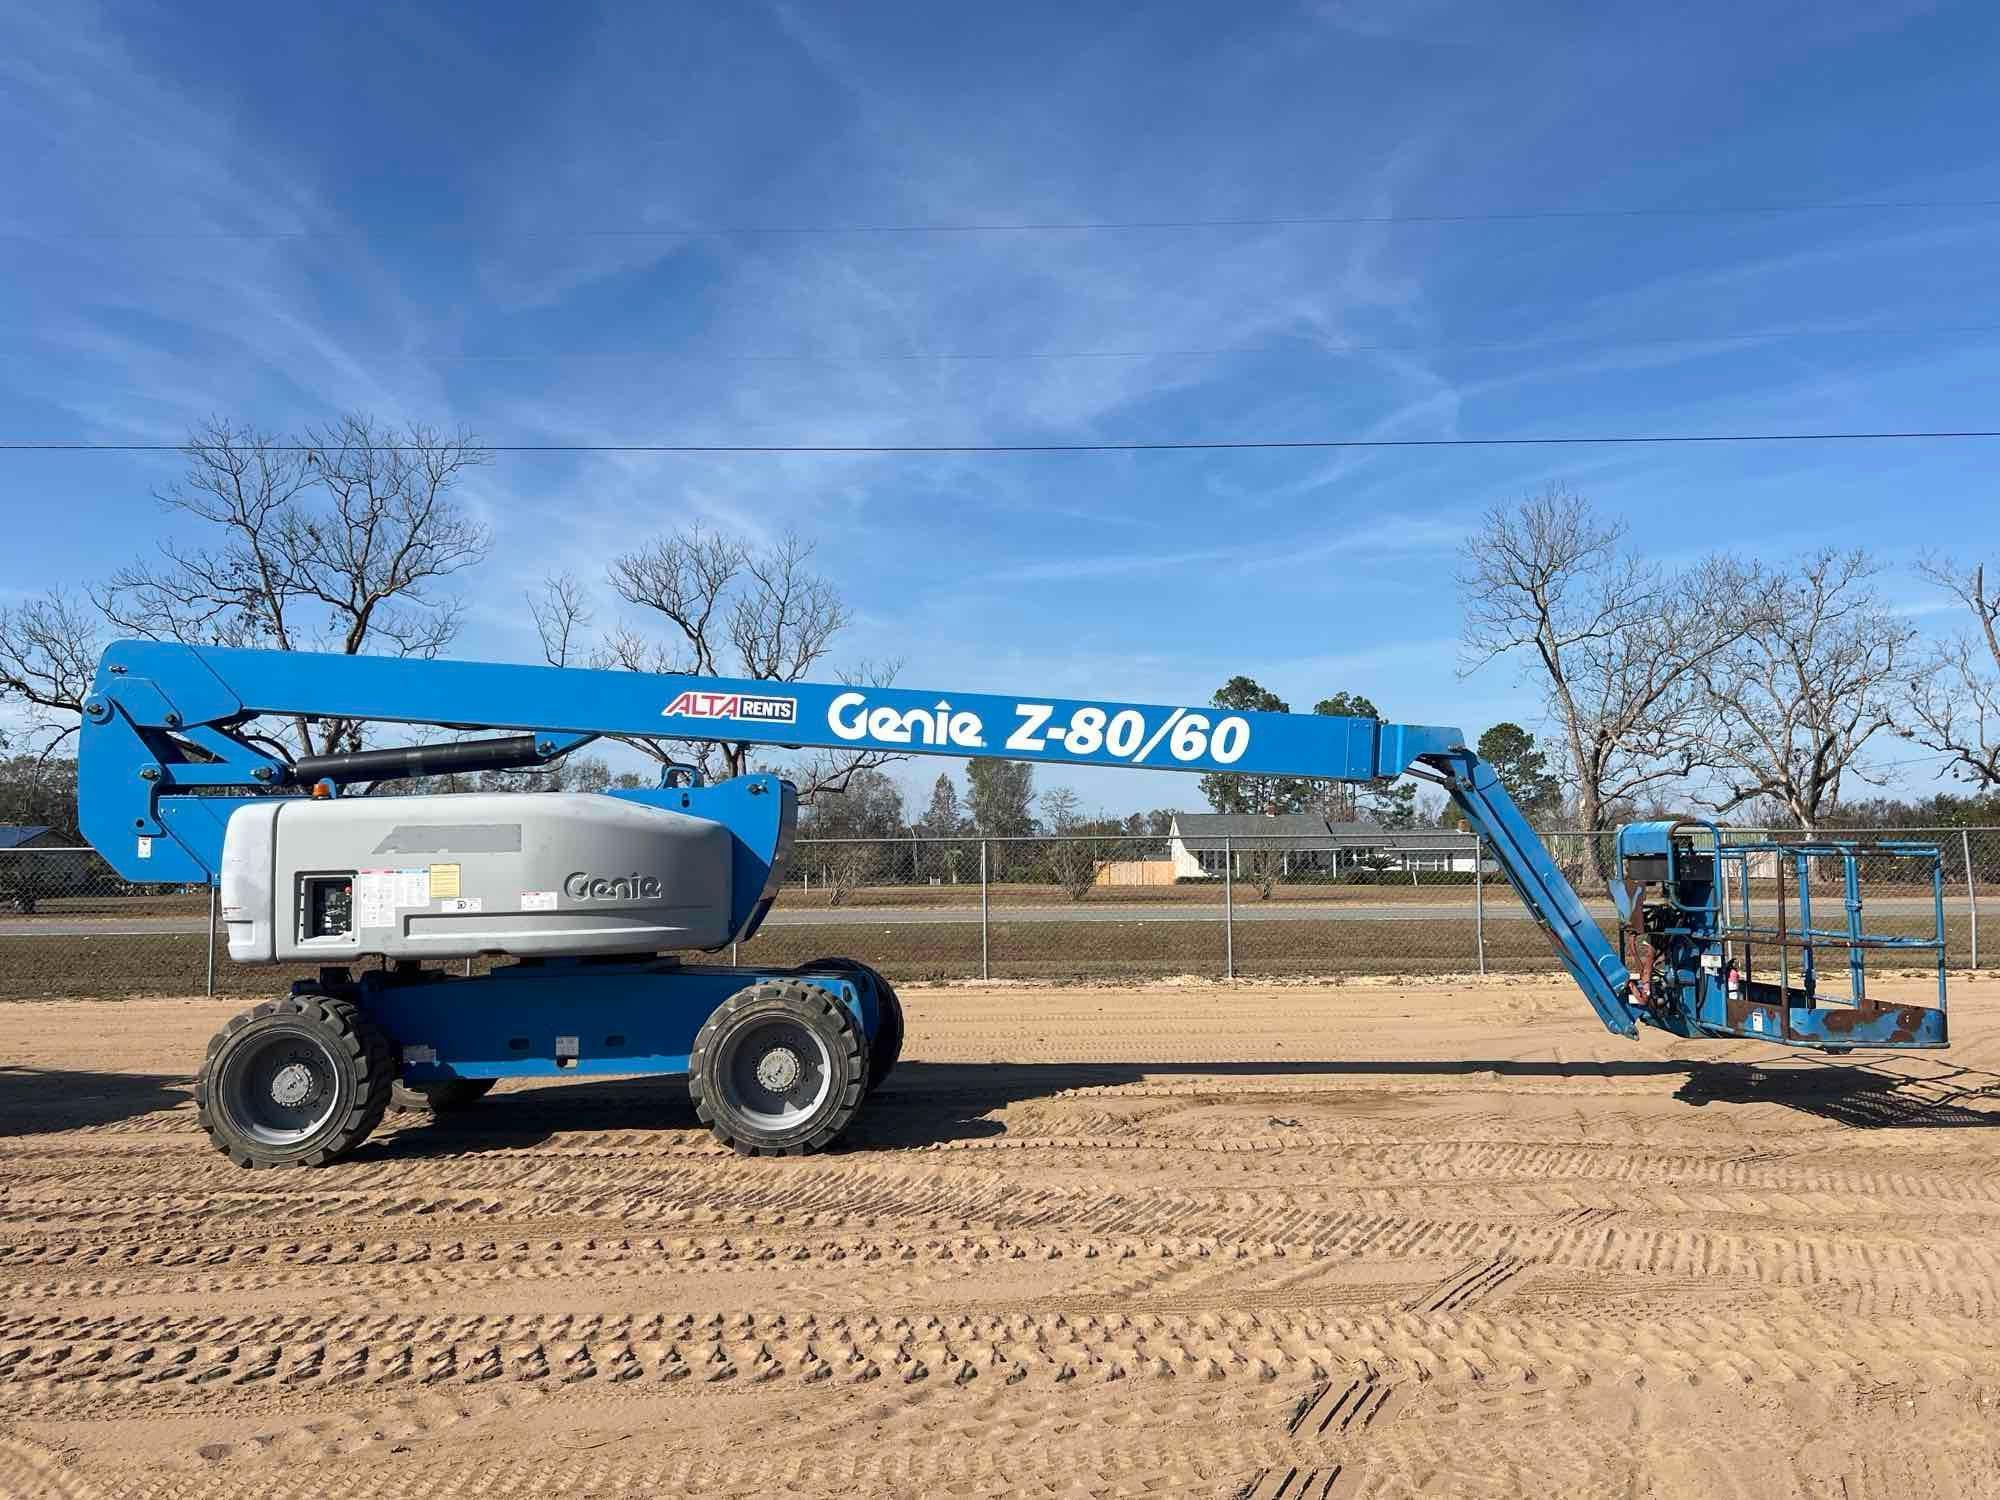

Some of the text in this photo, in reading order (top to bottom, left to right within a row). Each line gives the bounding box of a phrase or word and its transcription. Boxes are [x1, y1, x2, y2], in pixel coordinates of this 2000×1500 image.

[664, 693, 792, 718] ALTA RENTS
[827, 692, 1251, 764] Genie Z-80/60
[563, 872, 662, 902] Genie
